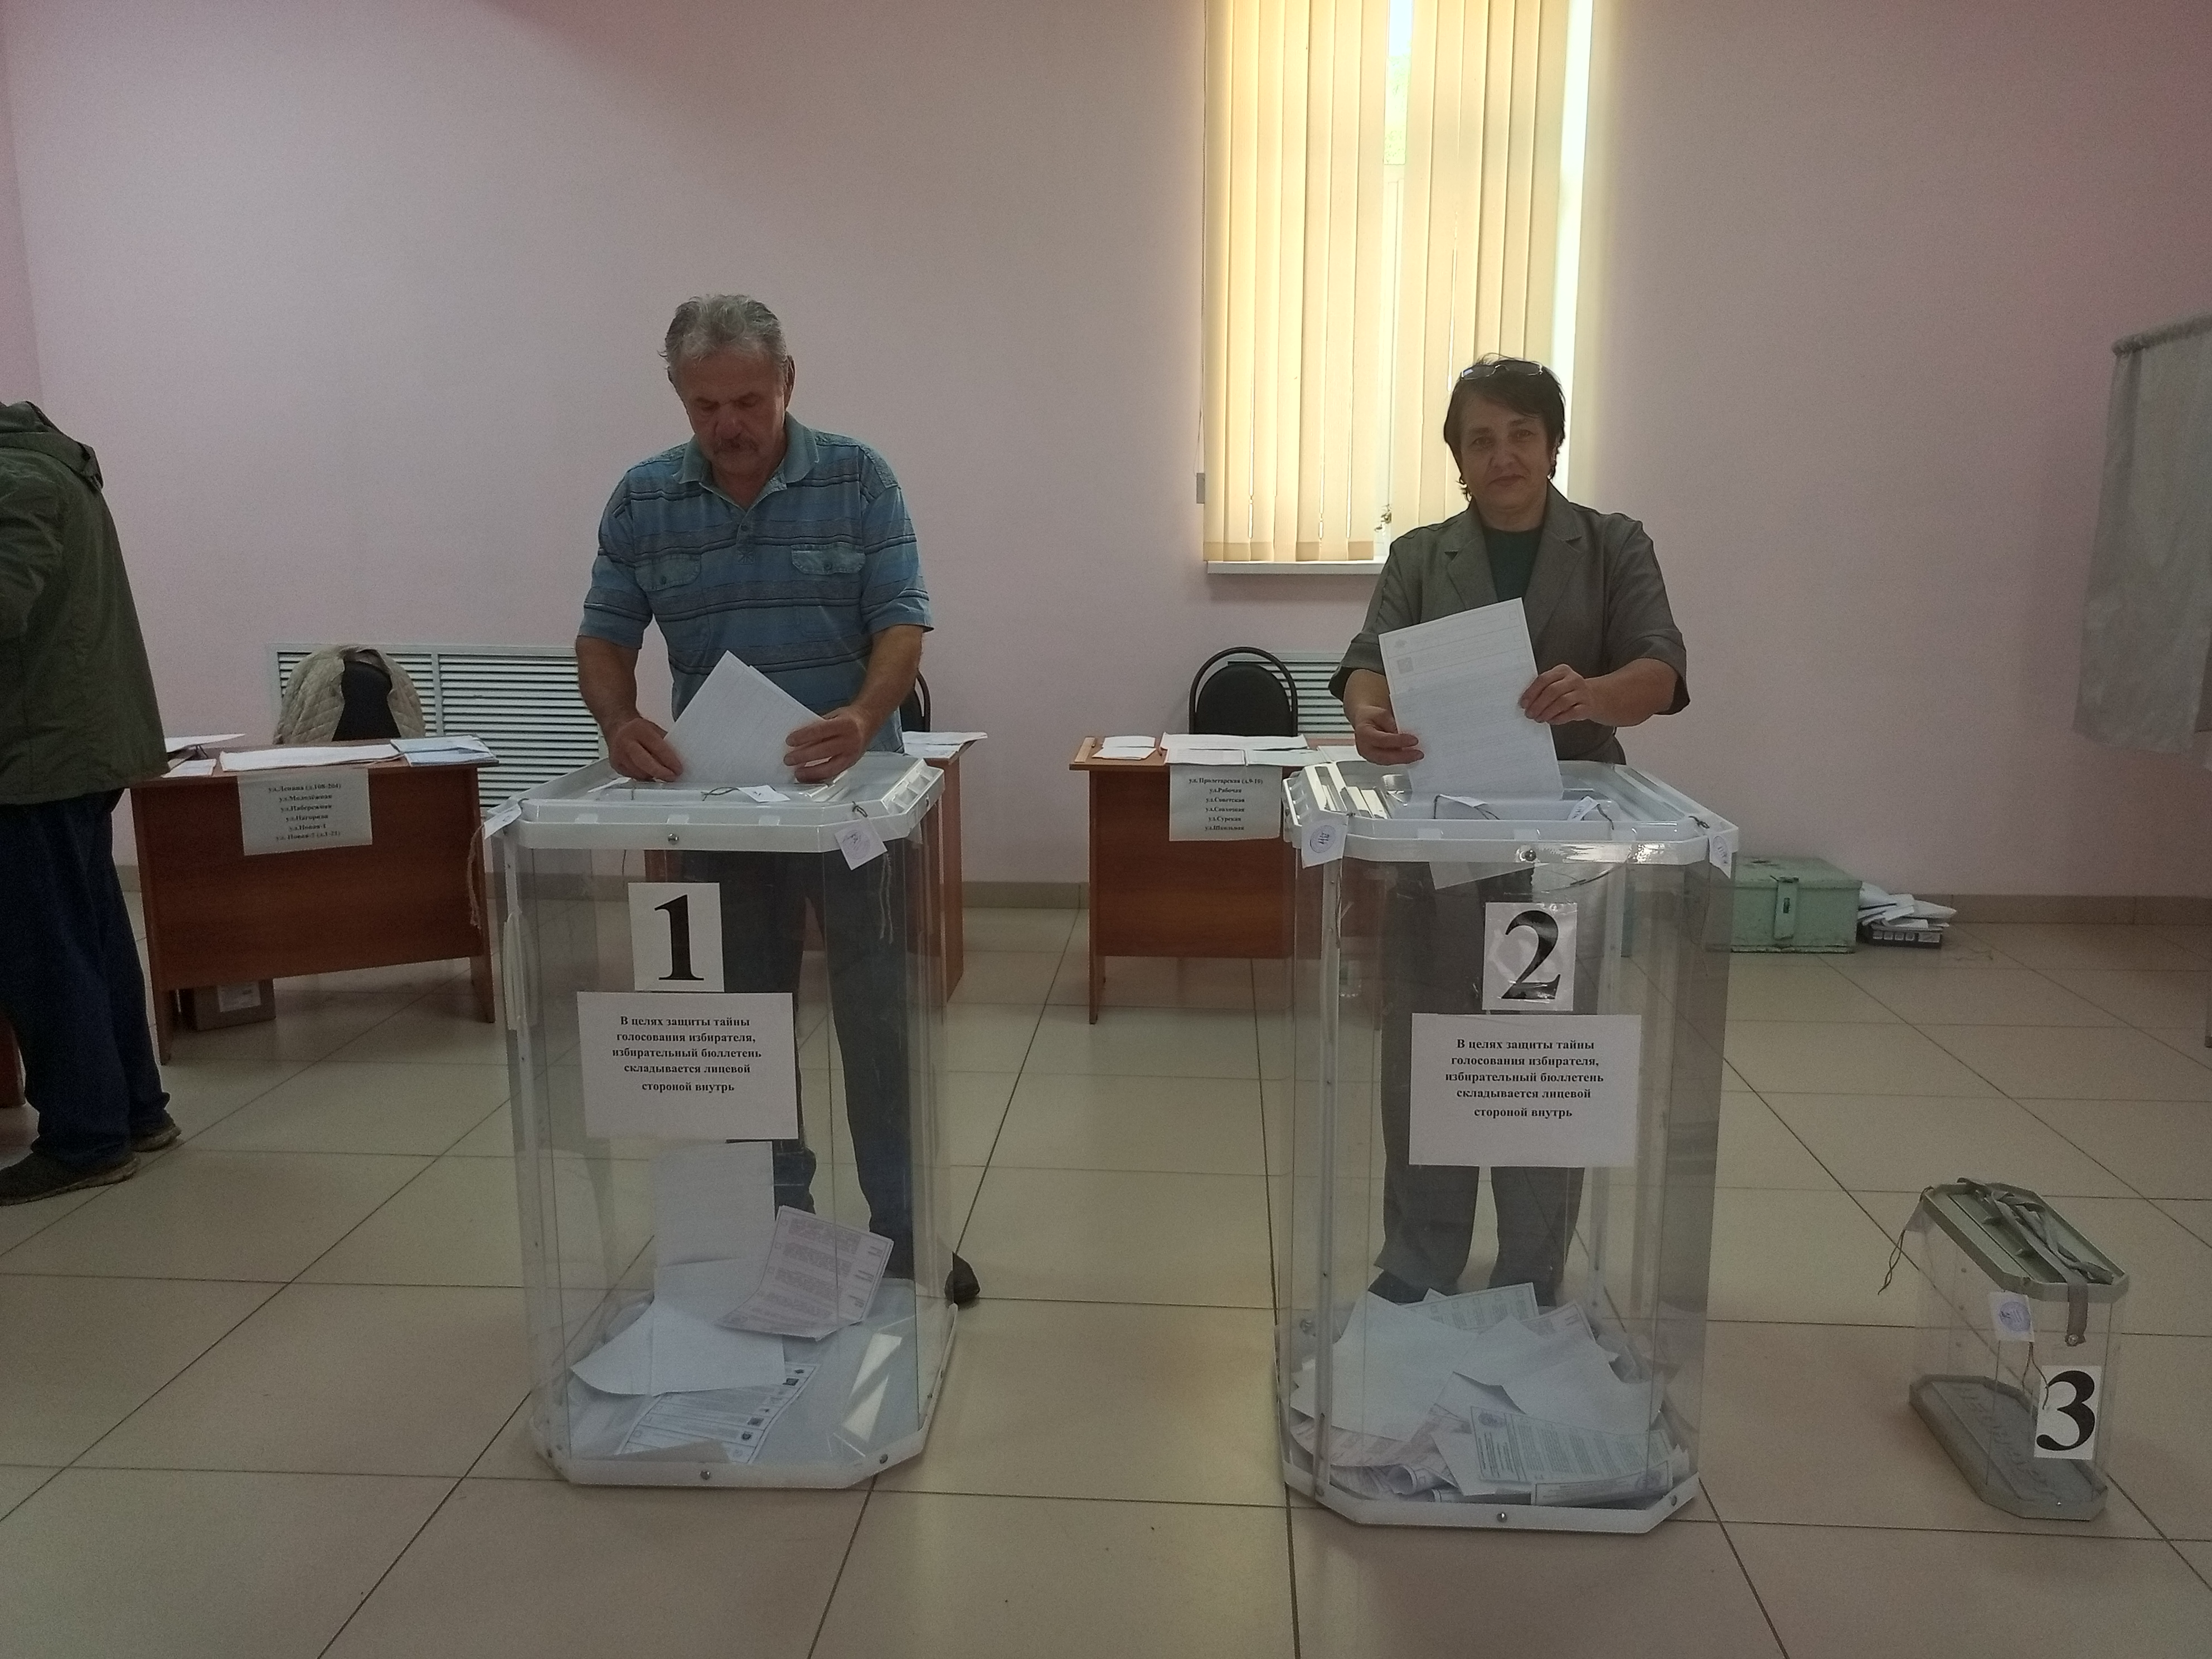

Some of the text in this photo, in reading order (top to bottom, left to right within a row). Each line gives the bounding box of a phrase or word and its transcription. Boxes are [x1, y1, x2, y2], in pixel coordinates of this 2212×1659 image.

[654, 894, 704, 980] 1
[1501, 910, 1561, 999] 2
[620, 1016, 750, 1028] В целях защиты тайны
[617, 1032, 755, 1044] голосования избирателя,
[1457, 1040, 1594, 1051] В целях защиты тайны
[612, 1048, 761, 1059] избирательный бюллетень
[1451, 1056, 1599, 1067] голосования избирателя,
[624, 1064, 750, 1075] складывается лицевой
[1445, 1072, 1603, 1084] избирательный бюллетень
[642, 1082, 734, 1093] стороной внутрь
[1457, 1089, 1590, 1099] складывается лицевой
[1474, 1108, 1573, 1118] стороной внутрь
[2036, 1370, 2095, 1451] 3
